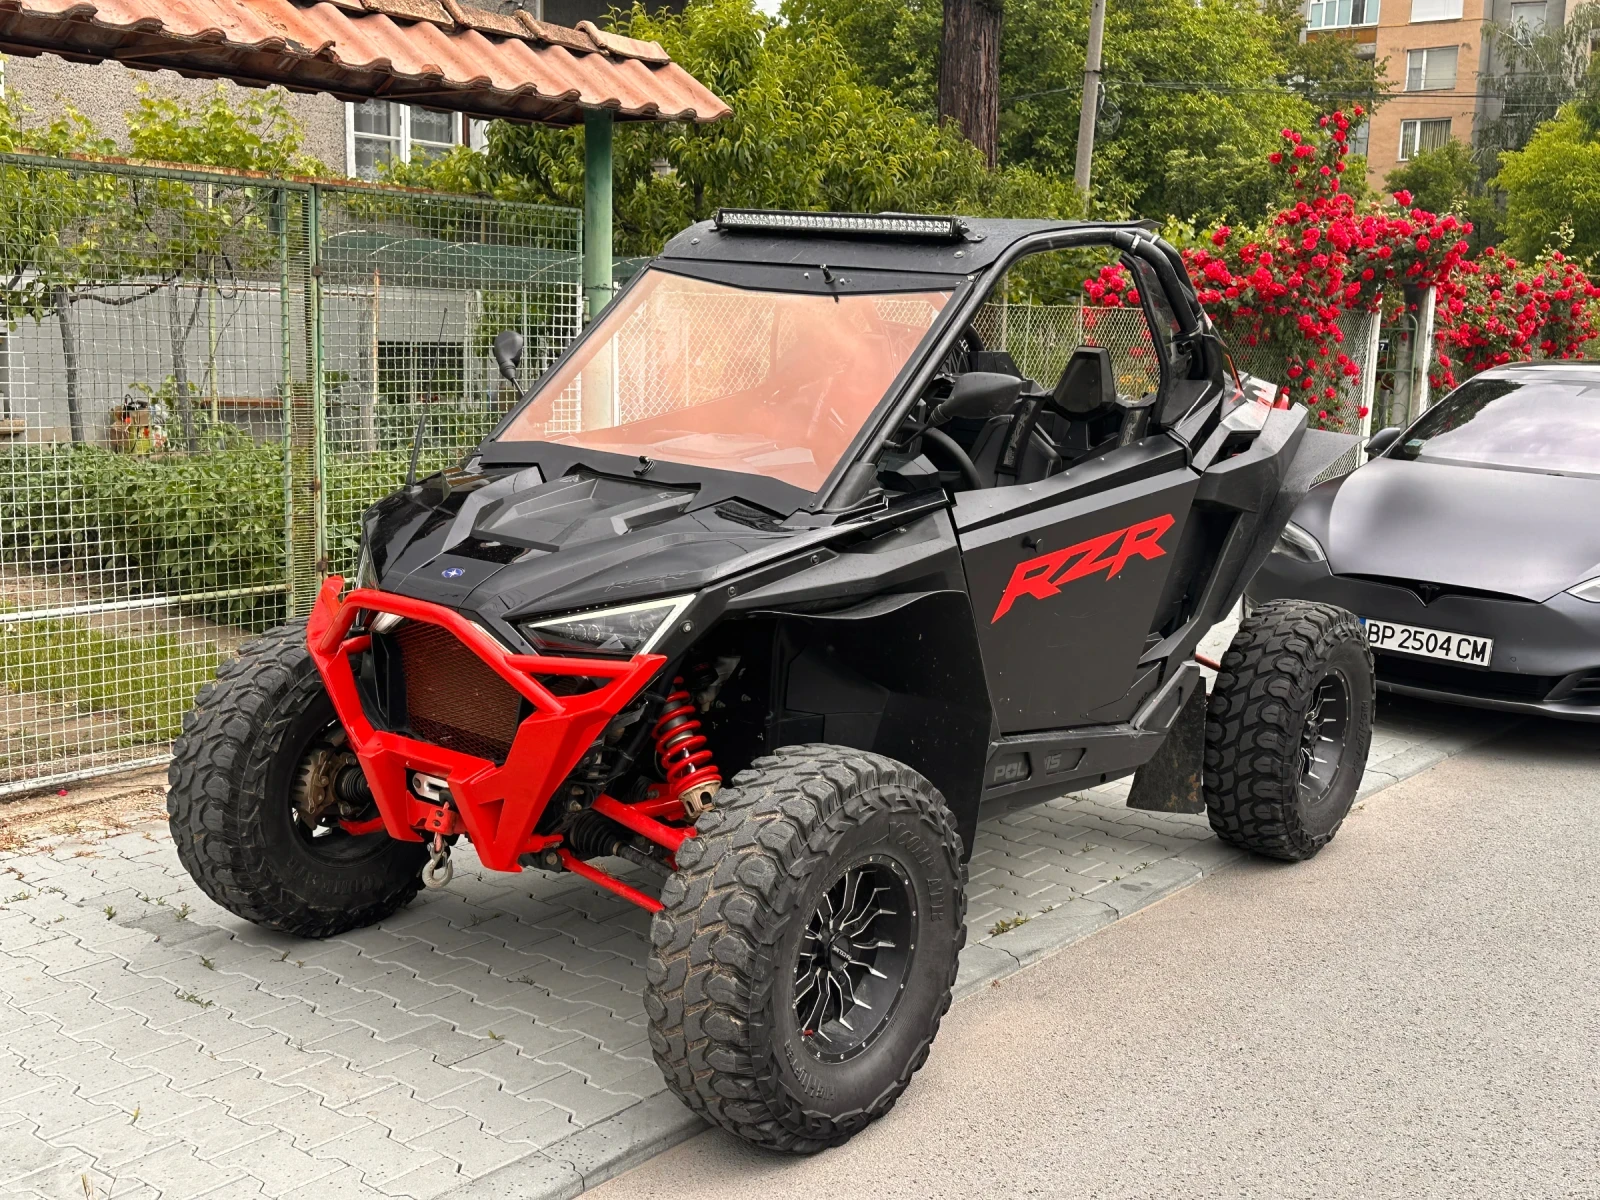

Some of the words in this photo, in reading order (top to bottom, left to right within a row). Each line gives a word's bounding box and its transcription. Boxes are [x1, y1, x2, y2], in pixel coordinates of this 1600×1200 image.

[991, 513, 1176, 624] RZR
[1367, 623, 1395, 645] BP
[1398, 628, 1452, 657] 2504
[1456, 638, 1488, 662] CM
